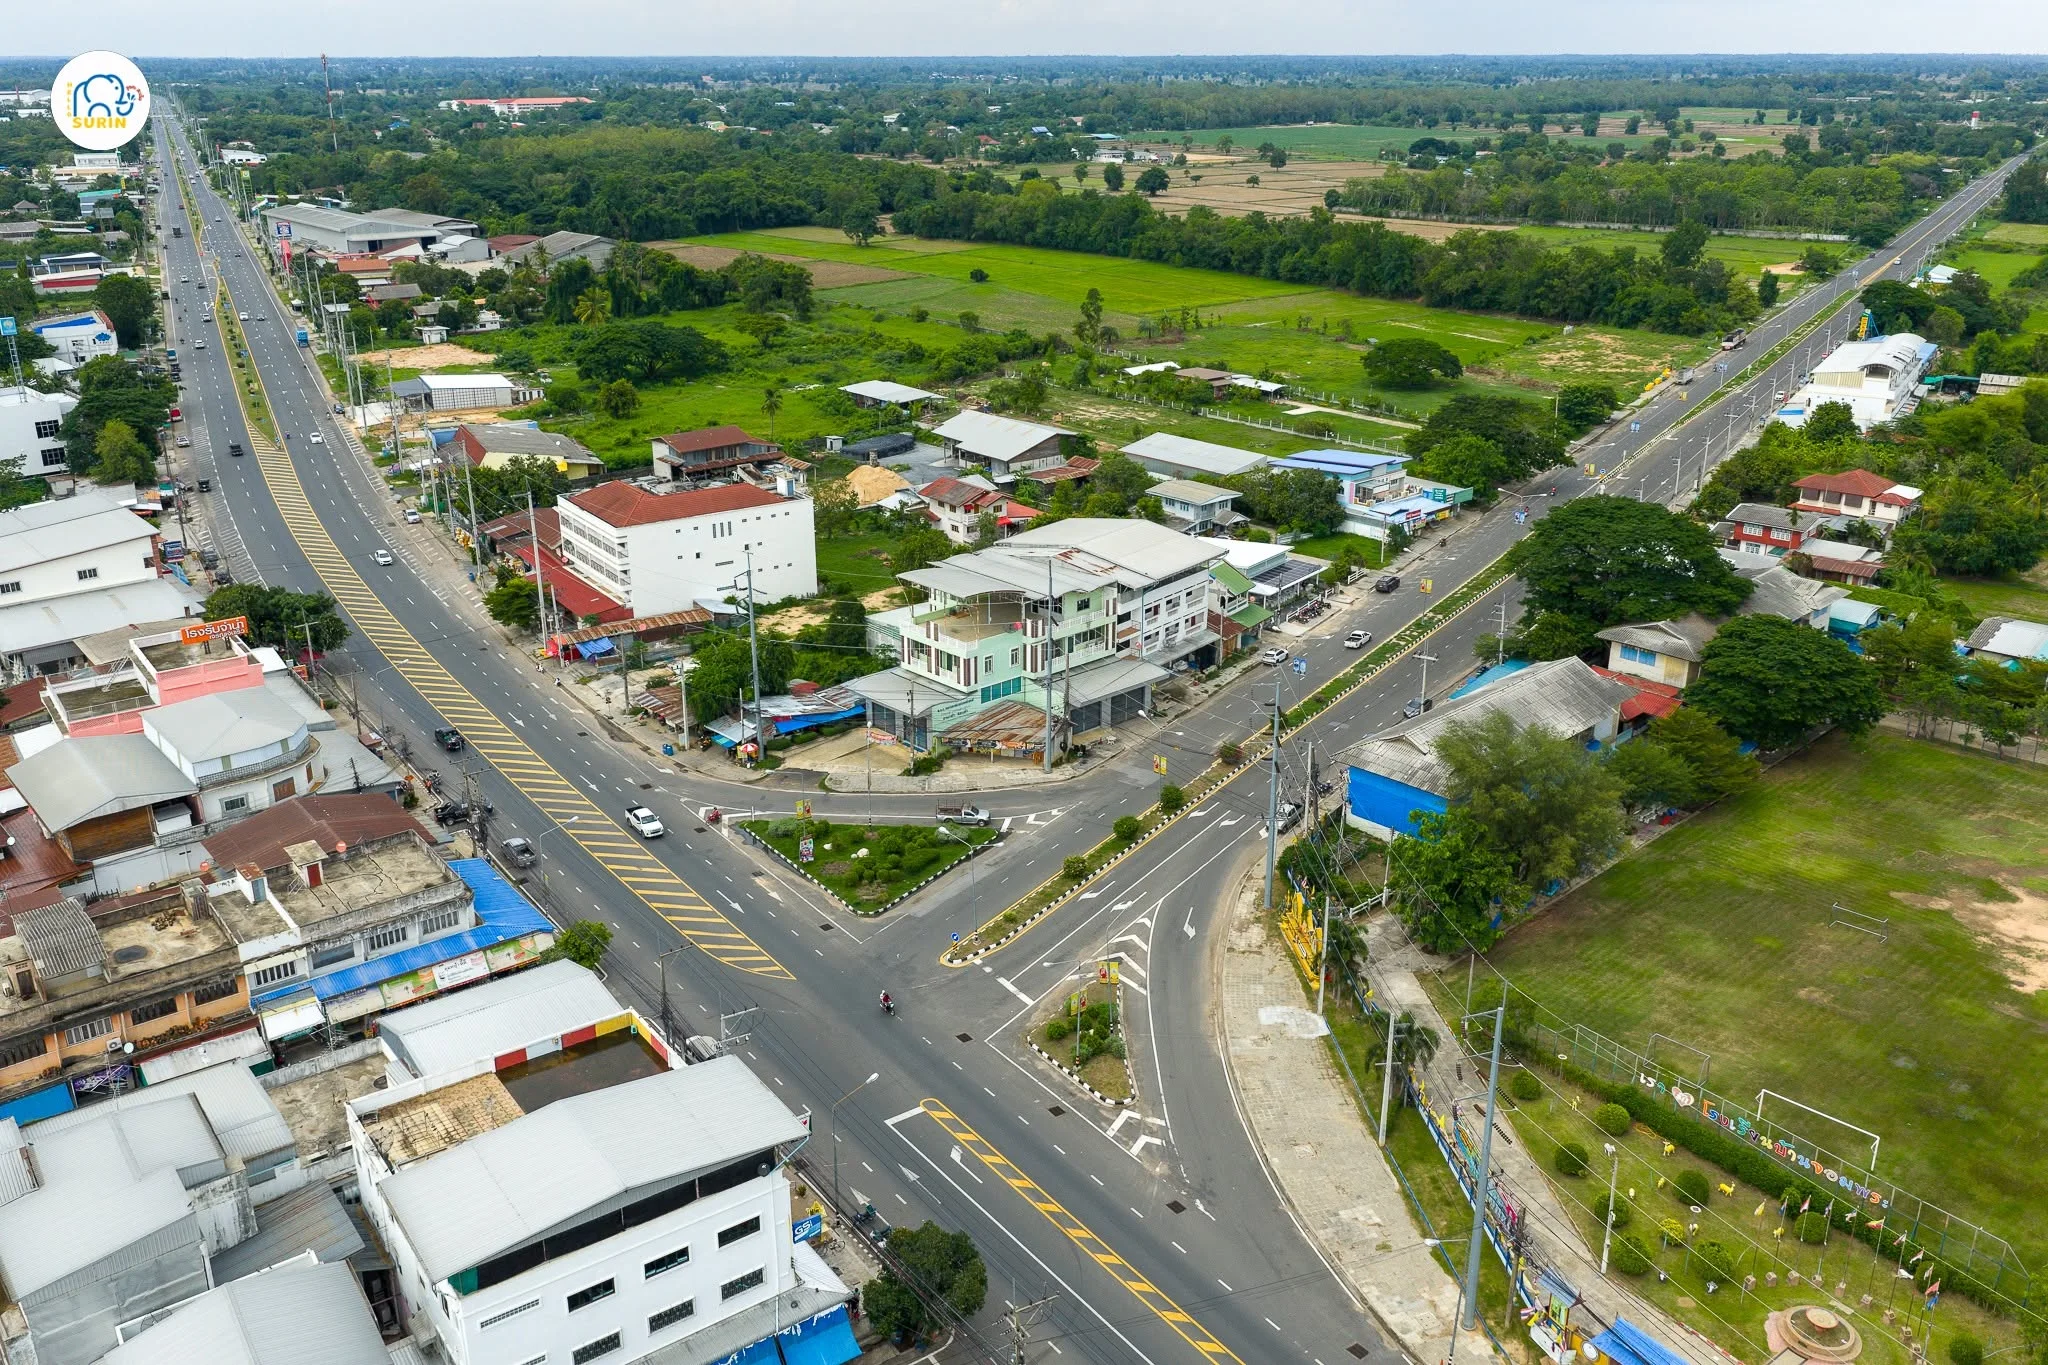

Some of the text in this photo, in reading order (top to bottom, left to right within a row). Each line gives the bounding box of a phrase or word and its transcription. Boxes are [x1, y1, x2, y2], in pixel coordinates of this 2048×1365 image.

[184, 619, 245, 639] โรงรับจำนำ
[1639, 1072, 1889, 1208] เรา โรงเรียนบ้านจอมพระ
